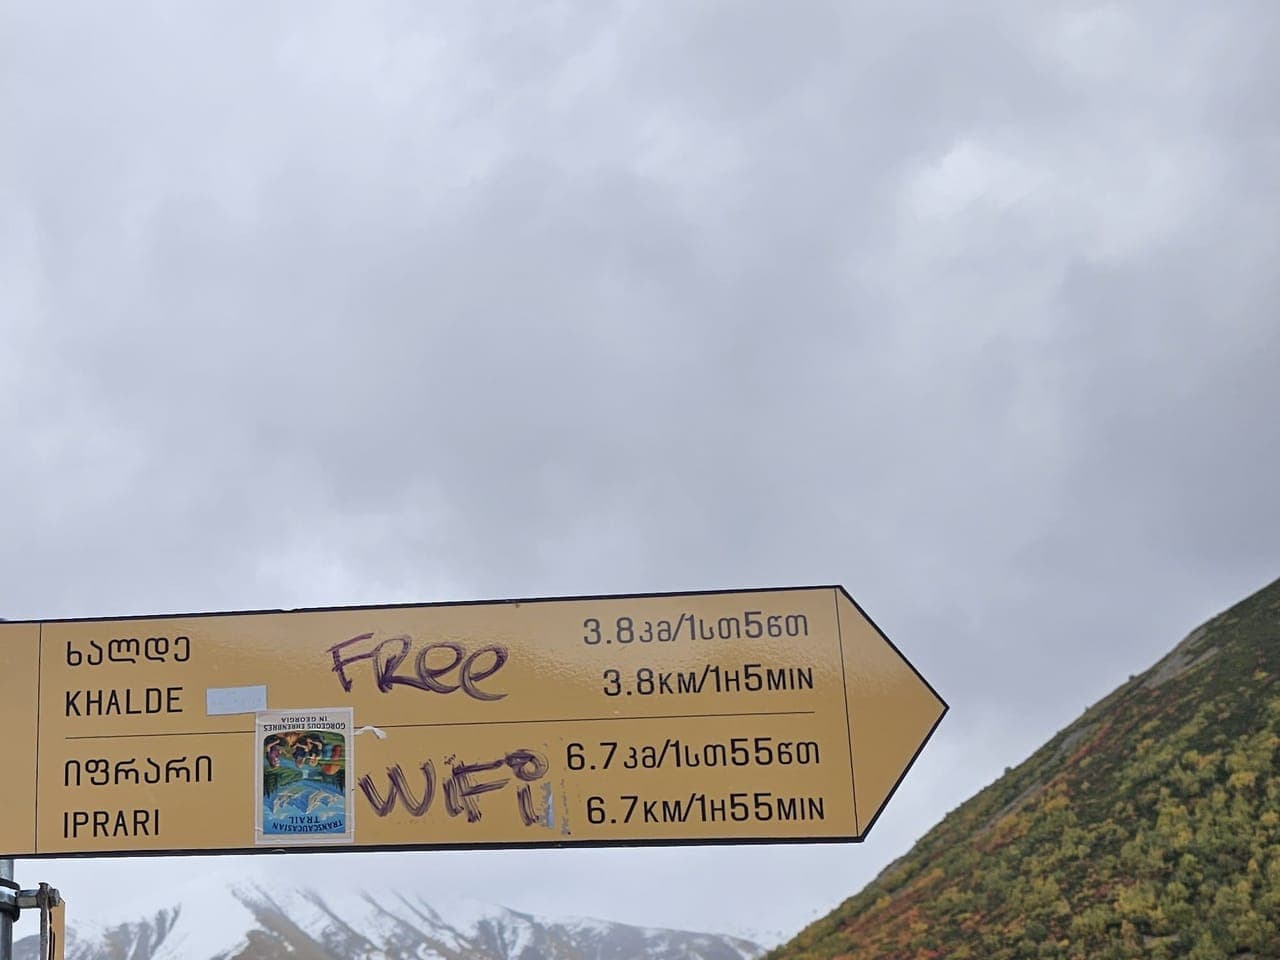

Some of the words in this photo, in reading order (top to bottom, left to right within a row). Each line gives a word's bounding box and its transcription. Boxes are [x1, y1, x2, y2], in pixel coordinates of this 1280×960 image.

[65, 635, 191, 667] ხალდე
[603, 663, 814, 697] 3.8KM/1H5MIN
[64, 686, 184, 718] KHALDE
[280, 716, 318, 724] GEORGIA
[307, 722, 346, 731] GORGEOUS
[319, 715, 328, 723] IN
[63, 755, 213, 788] იფრარი
[63, 808, 161, 840] IPRARI
[288, 815, 320, 824] TRAIL
[586, 793, 825, 826] 6.7KM/1H55MIN
[272, 819, 344, 833] TRANSCAUCASIAN
